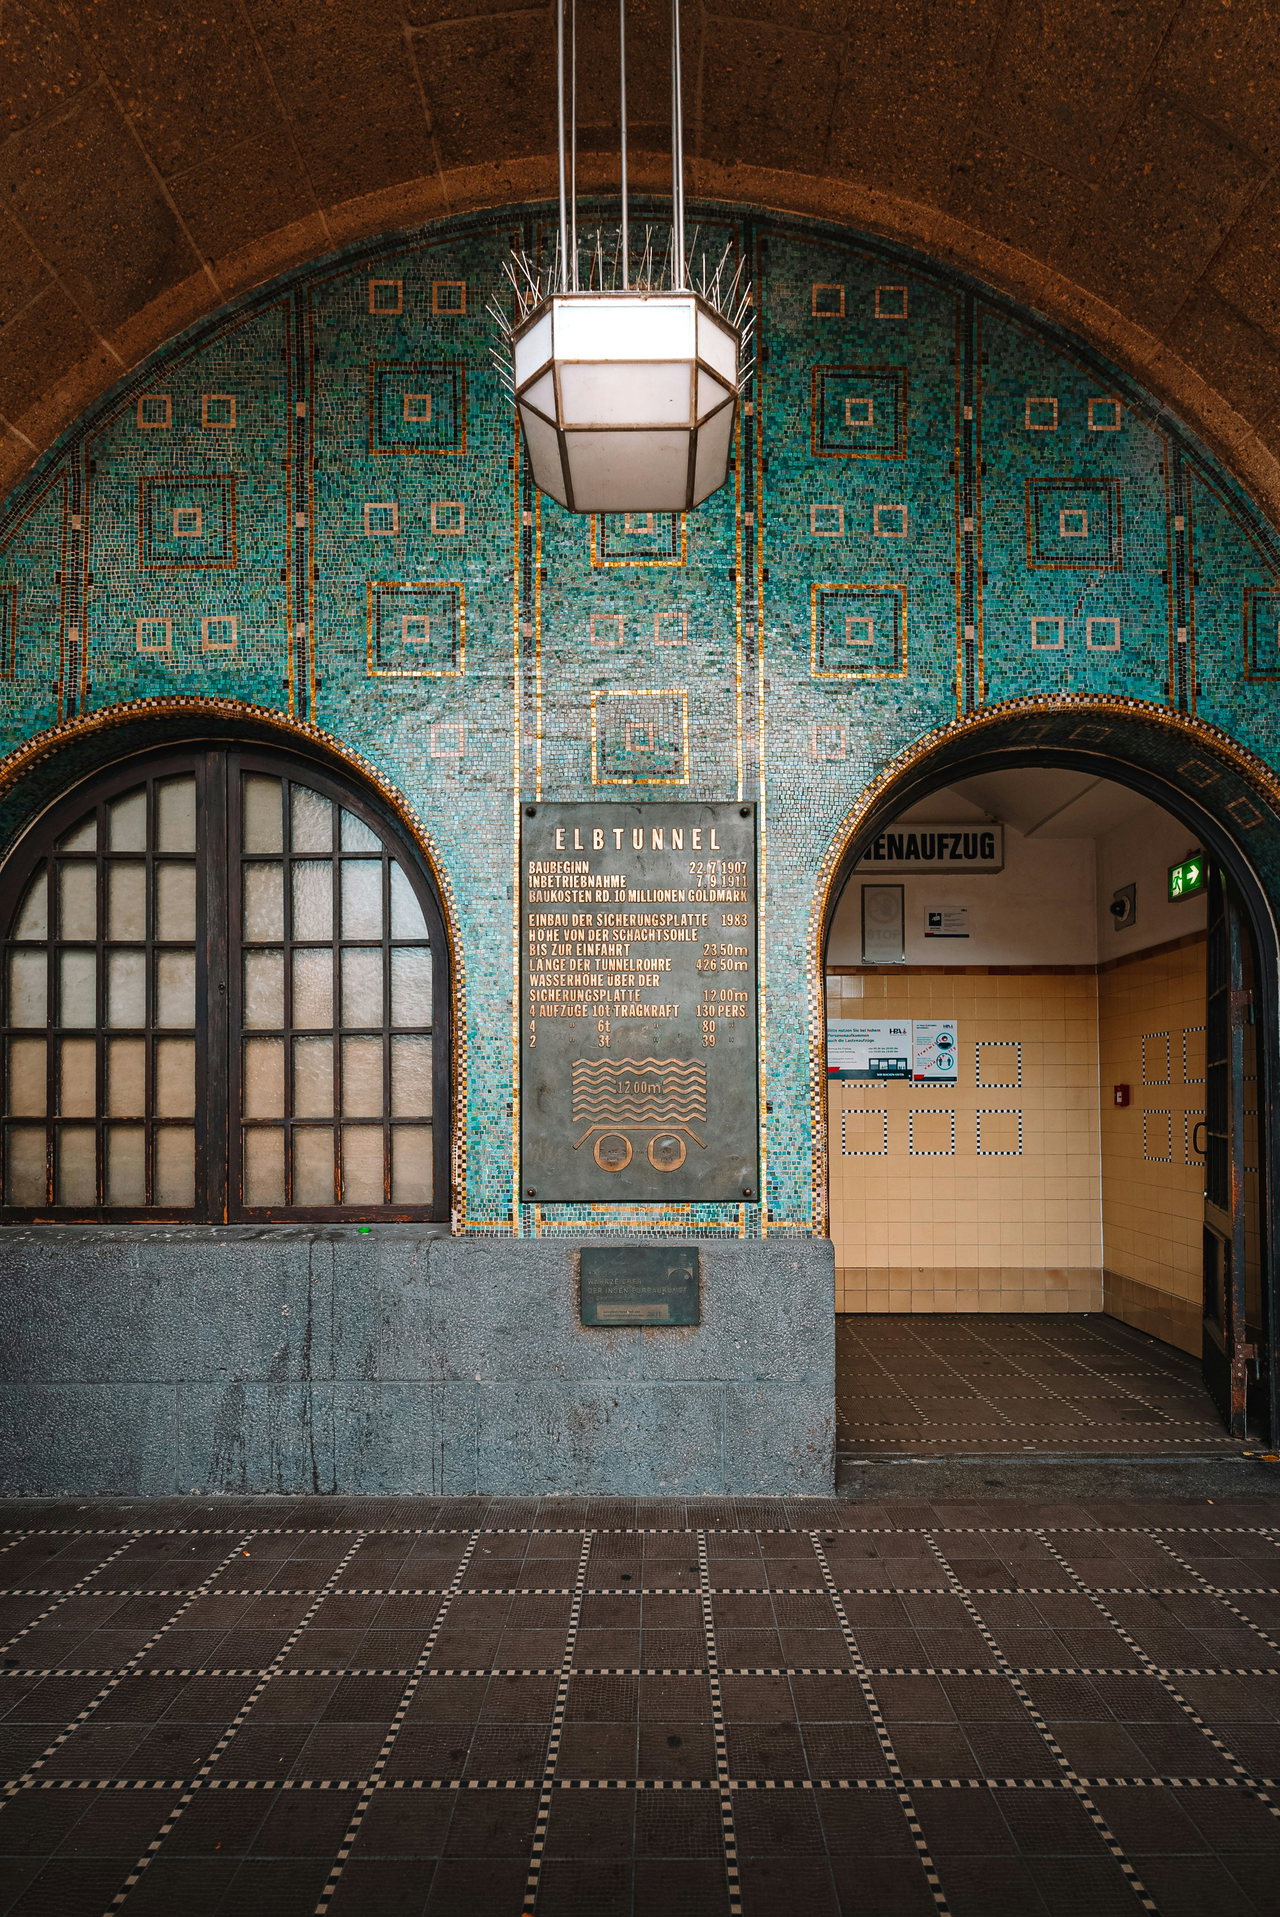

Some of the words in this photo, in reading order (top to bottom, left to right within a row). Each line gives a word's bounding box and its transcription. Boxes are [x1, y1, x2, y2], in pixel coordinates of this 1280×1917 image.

[555, 828, 721, 850] ELBTUNNEL
[528, 861, 589, 874] BAUBEGINN
[528, 875, 627, 888] INBETRIEBNAHME
[528, 889, 592, 903] BAUKOSTEN
[595, 889, 612, 902] RD.
[614, 889, 626, 902] 10
[628, 889, 685, 902] MILLIONEN
[688, 889, 748, 902] GOLDMARK
[528, 914, 568, 927] EINBAU
[572, 914, 593, 927] DER
[596, 914, 708, 927] SICHERUNGSPLATTE
[721, 914, 748, 927] 1983
[528, 927, 560, 942] HÖHE
[564, 929, 585, 942] VON
[588, 929, 610, 942] DER
[612, 929, 698, 942] SCHACHTSOHLE
[529, 943, 547, 957] BIS
[551, 943, 572, 957] ZUR
[576, 943, 631, 957] EINFAHRT
[529, 957, 566, 971] LÄNGE
[569, 958, 591, 971] DER
[595, 958, 672, 971] TUNNELROHRE
[529, 973, 604, 987] WASSERHÖHE
[607, 973, 635, 987] ÜBER
[638, 974, 660, 987] DER
[529, 989, 641, 1002] SICHERUNGSPLATTE
[529, 1004, 536, 1017] 4
[539, 1004, 588, 1017] AUFZÜGE
[592, 1004, 611, 1017] 10t
[614, 1004, 680, 1017] TRAGKRAFT
[696, 1004, 715, 1017] 130
[529, 1020, 536, 1033] 4
[597, 1020, 611, 1033] 6t
[702, 1020, 716, 1033] 80
[529, 1035, 536, 1048] 2
[597, 1035, 611, 1048] 3t
[702, 1035, 716, 1048] 39
